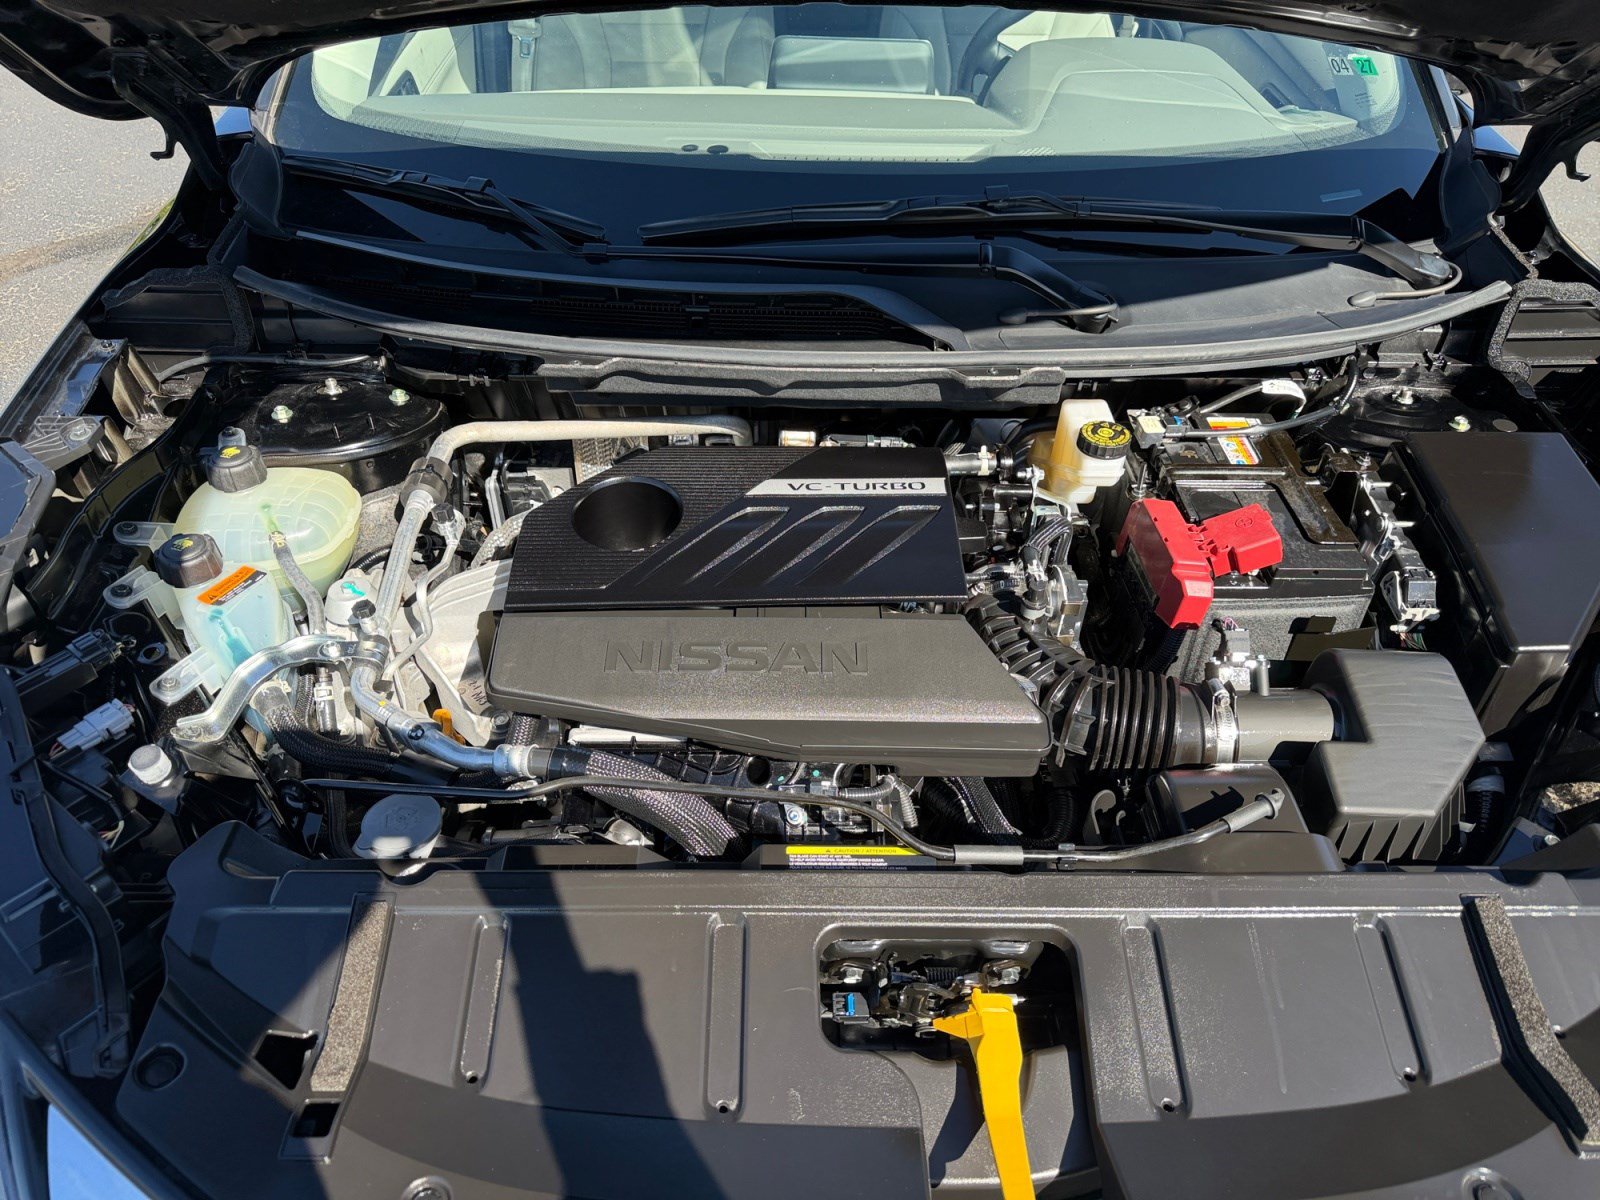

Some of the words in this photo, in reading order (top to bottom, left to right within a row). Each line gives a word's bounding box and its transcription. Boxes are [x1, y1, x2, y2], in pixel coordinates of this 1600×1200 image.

[1330, 58, 1349, 73] 04
[1356, 60, 1373, 74] 27
[787, 481, 926, 491] VC-TURBO
[603, 640, 869, 676] NISSAN
